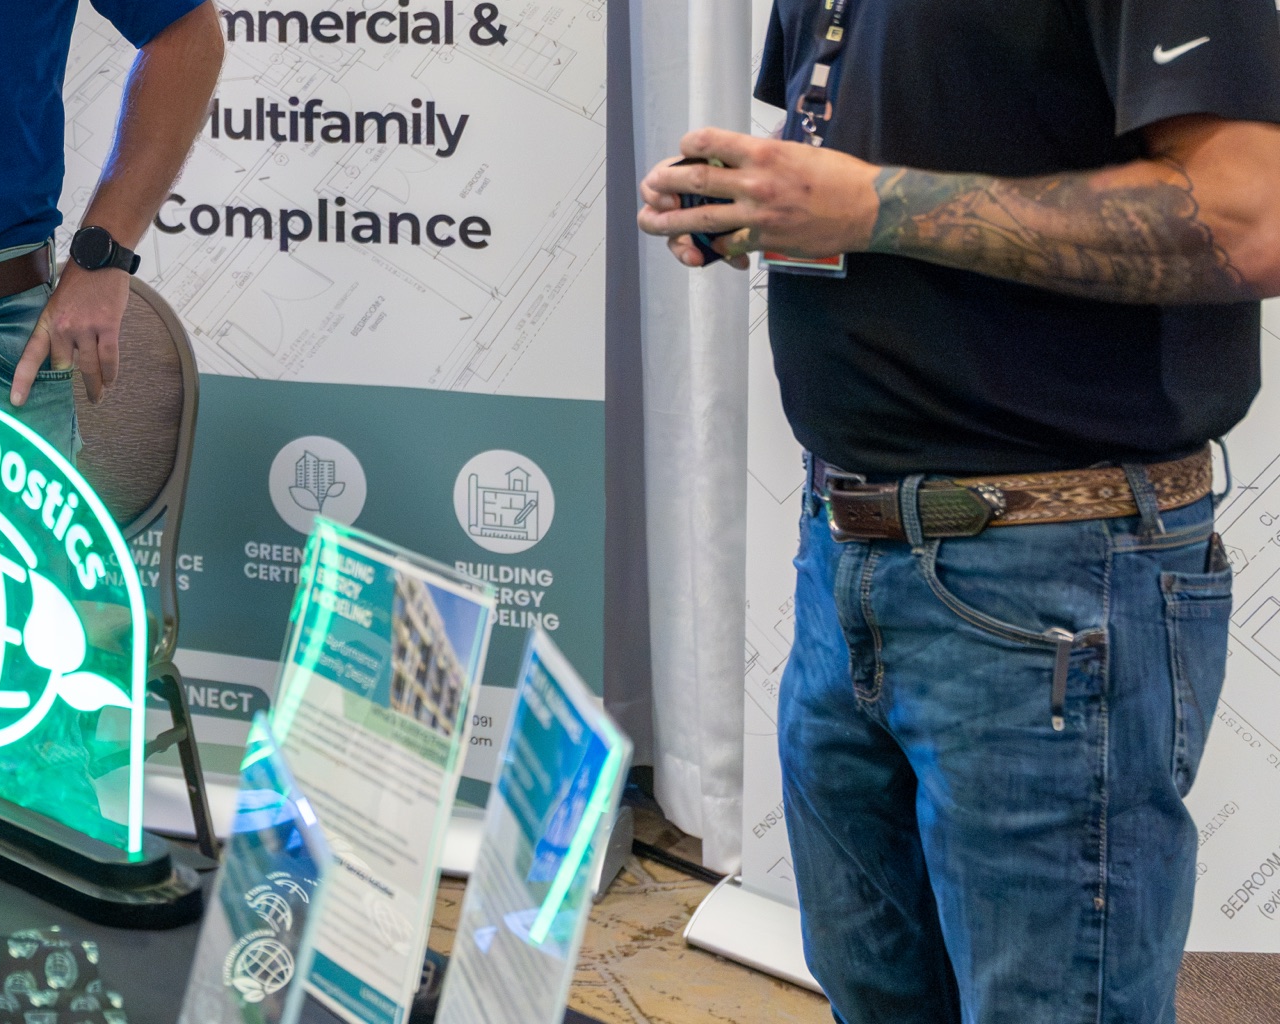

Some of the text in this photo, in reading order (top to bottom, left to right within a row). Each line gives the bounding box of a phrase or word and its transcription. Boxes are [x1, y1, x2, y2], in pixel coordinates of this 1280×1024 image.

[468, 2, 509, 47] &
[210, 96, 470, 158] ultifamily
[153, 192, 492, 252] Compliance
[133, 530, 163, 547] ILIT
[244, 540, 306, 564] GREEN
[243, 562, 299, 584] CERTI
[454, 561, 554, 587] BUILDING
[494, 587, 545, 608] ERGY
[490, 608, 560, 631] DELING
[186, 684, 253, 713] NECT
[472, 714, 493, 728] 091
[470, 735, 493, 747] om
[1197, 800, 1240, 851] EARING)
